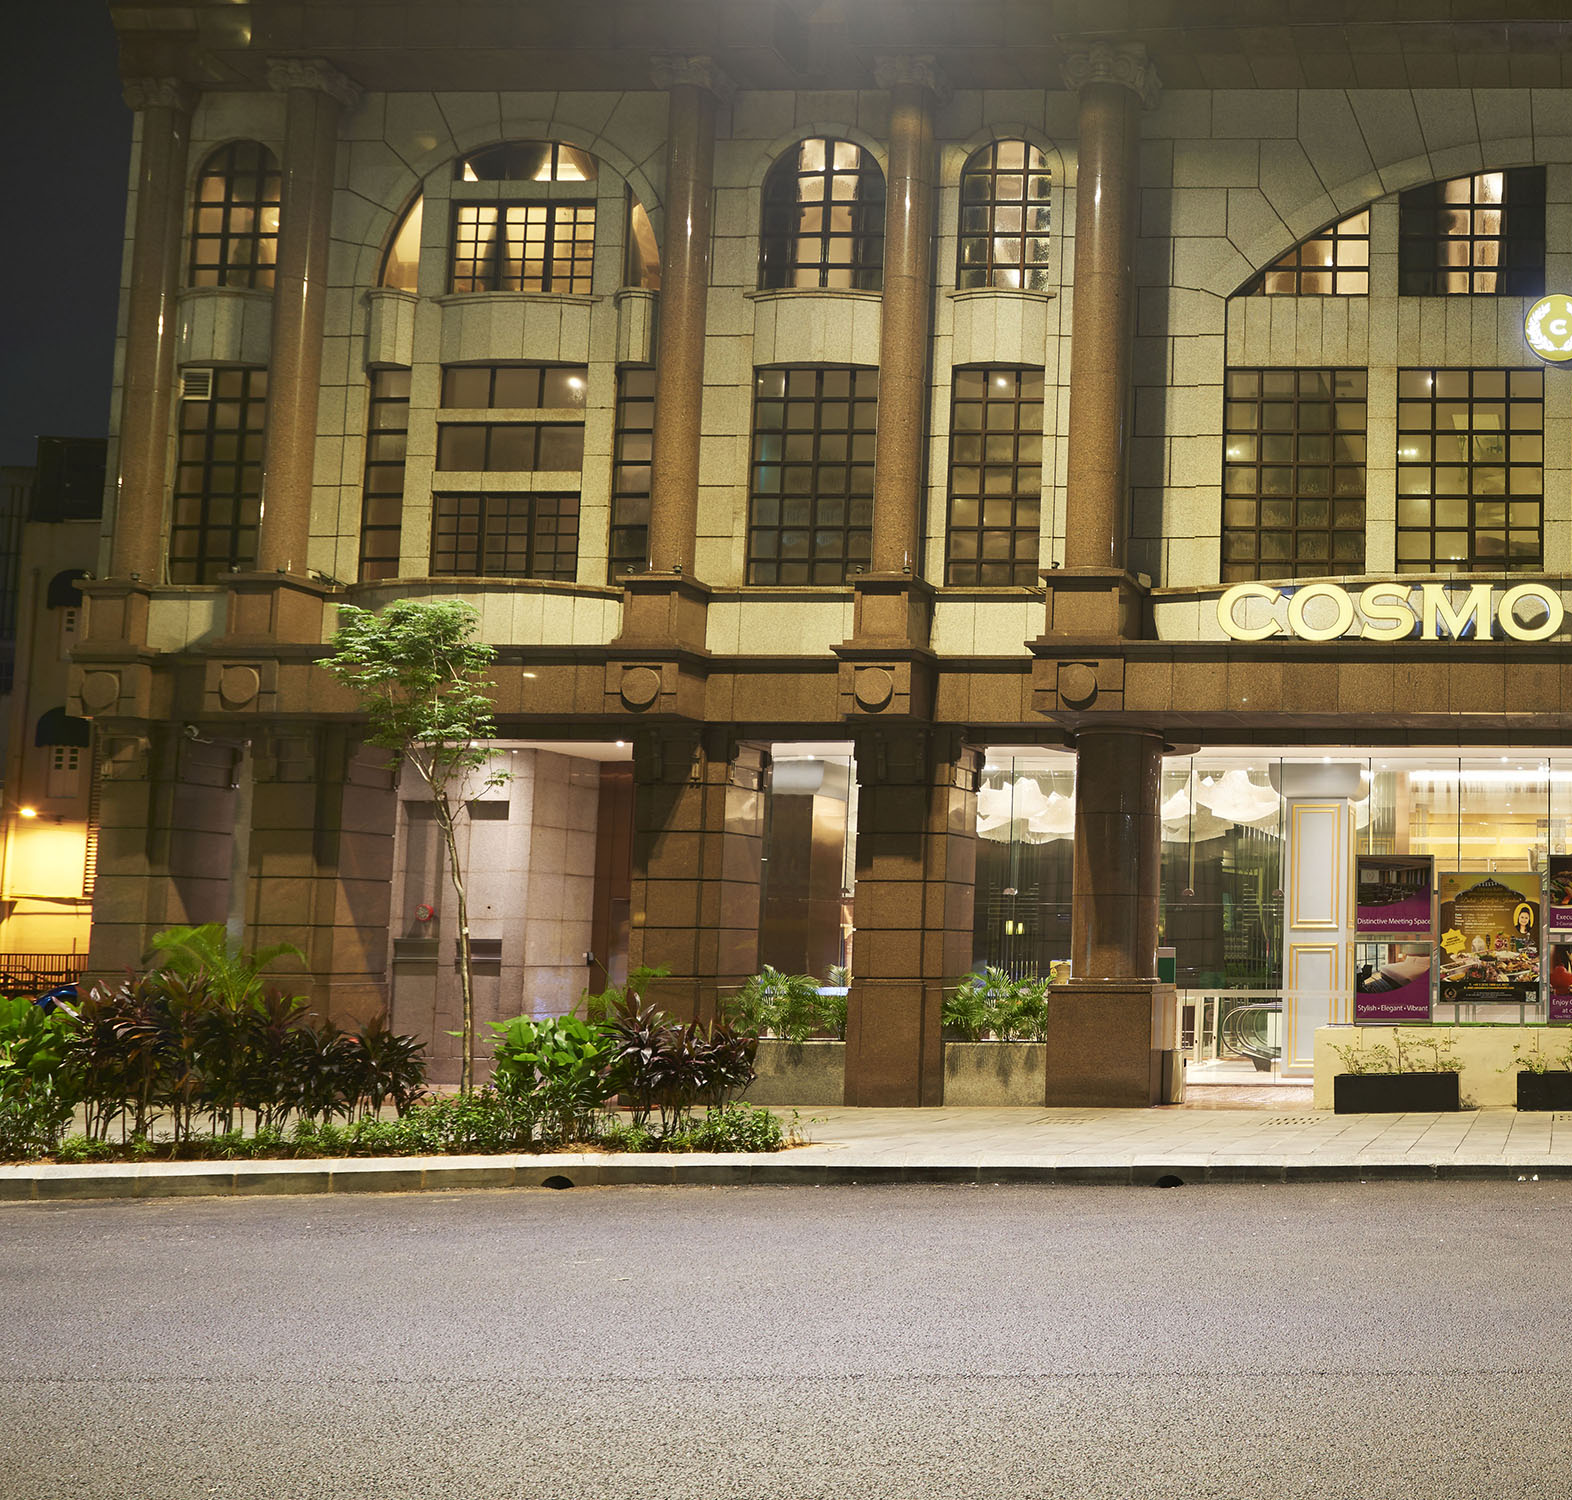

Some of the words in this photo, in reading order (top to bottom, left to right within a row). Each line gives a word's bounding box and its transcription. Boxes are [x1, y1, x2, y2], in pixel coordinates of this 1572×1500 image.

[1549, 318, 1568, 336] C
[1217, 583, 1564, 641] COSMO
[1357, 917, 1388, 925] Distinctive
[1388, 917, 1413, 926] Meeting
[1552, 998, 1569, 1007] Enjoy
[1357, 1004, 1377, 1013] Stylish
[1380, 1004, 1403, 1013] Elegant
[1406, 1004, 1428, 1012] Vibrant
